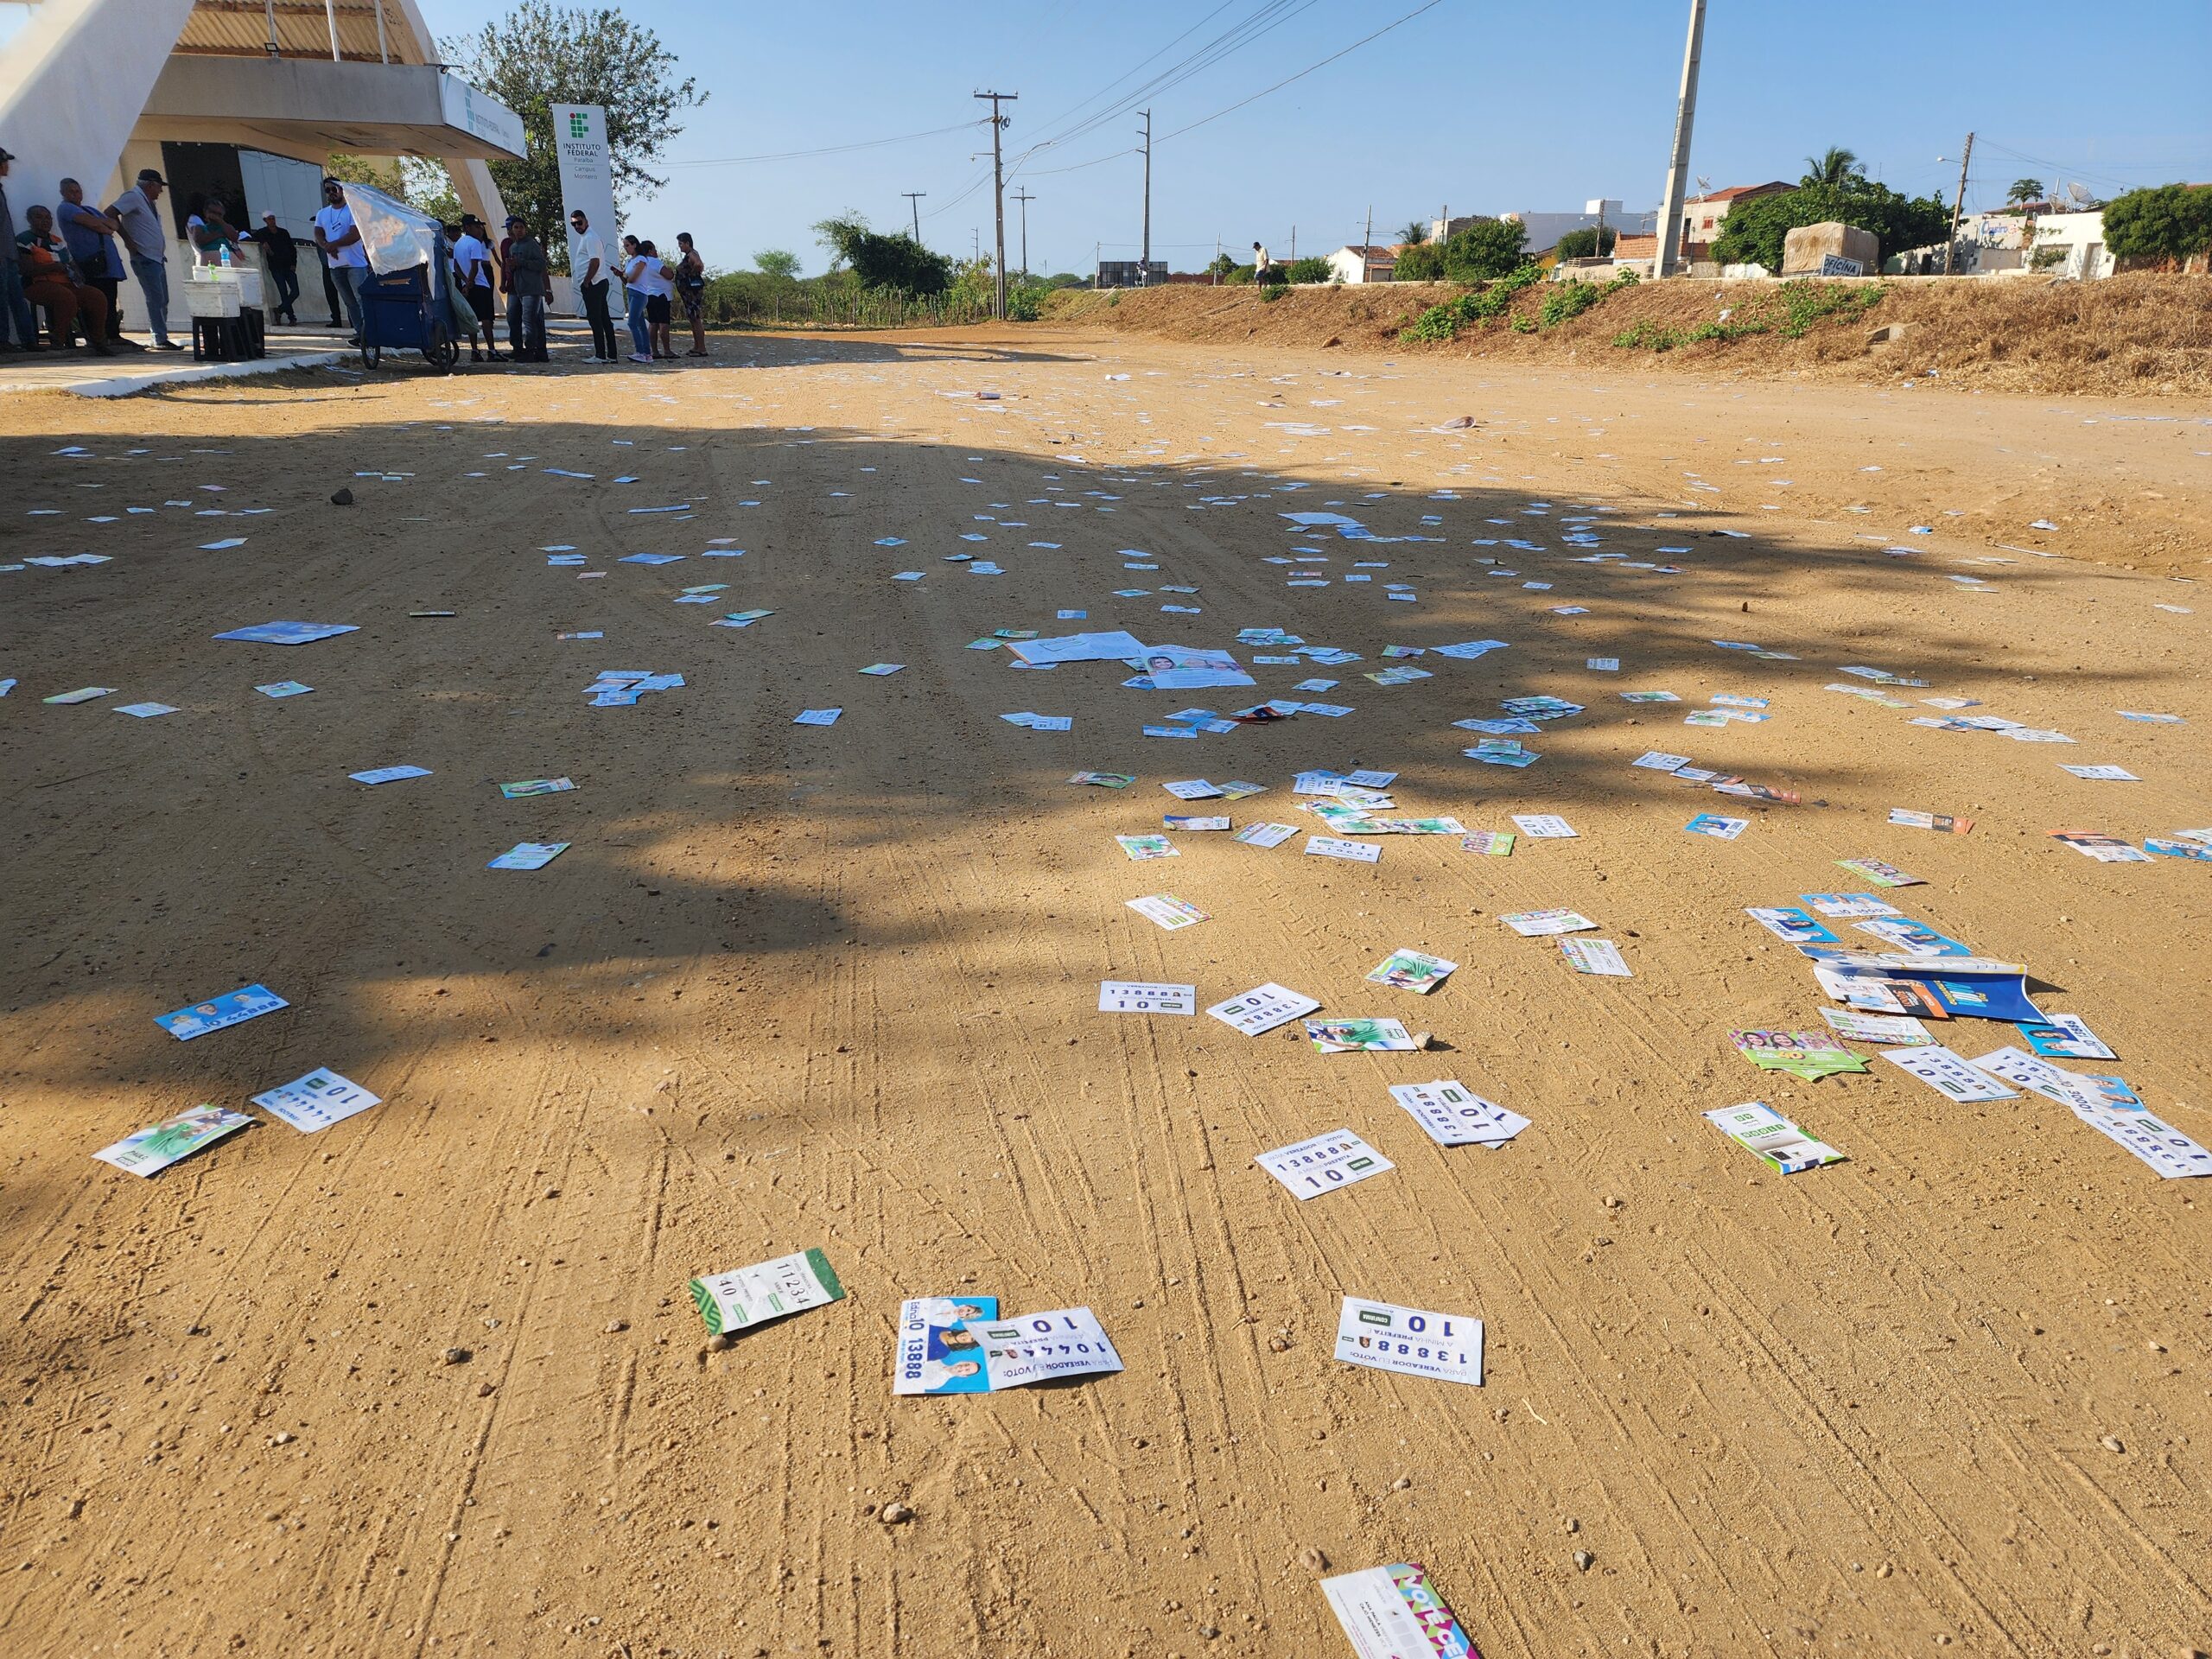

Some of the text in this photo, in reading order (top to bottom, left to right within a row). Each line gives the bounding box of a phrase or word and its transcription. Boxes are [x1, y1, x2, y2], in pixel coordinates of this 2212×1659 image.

[1824, 257, 1856, 274] OFICINA
[226, 1001, 280, 1022] 44888
[909, 1301, 925, 1331] Edna10
[1362, 1313, 1389, 1324] CONFIRMA
[1374, 1329, 1414, 1341] PREFEITA
[906, 1338, 924, 1379] 13888
[1350, 1351, 1377, 1362] VOTO:
[1046, 1360, 1091, 1370] VEREADOR
[1392, 1359, 1442, 1372] VEREADOR
[1003, 1366, 1032, 1377] VOTO:
